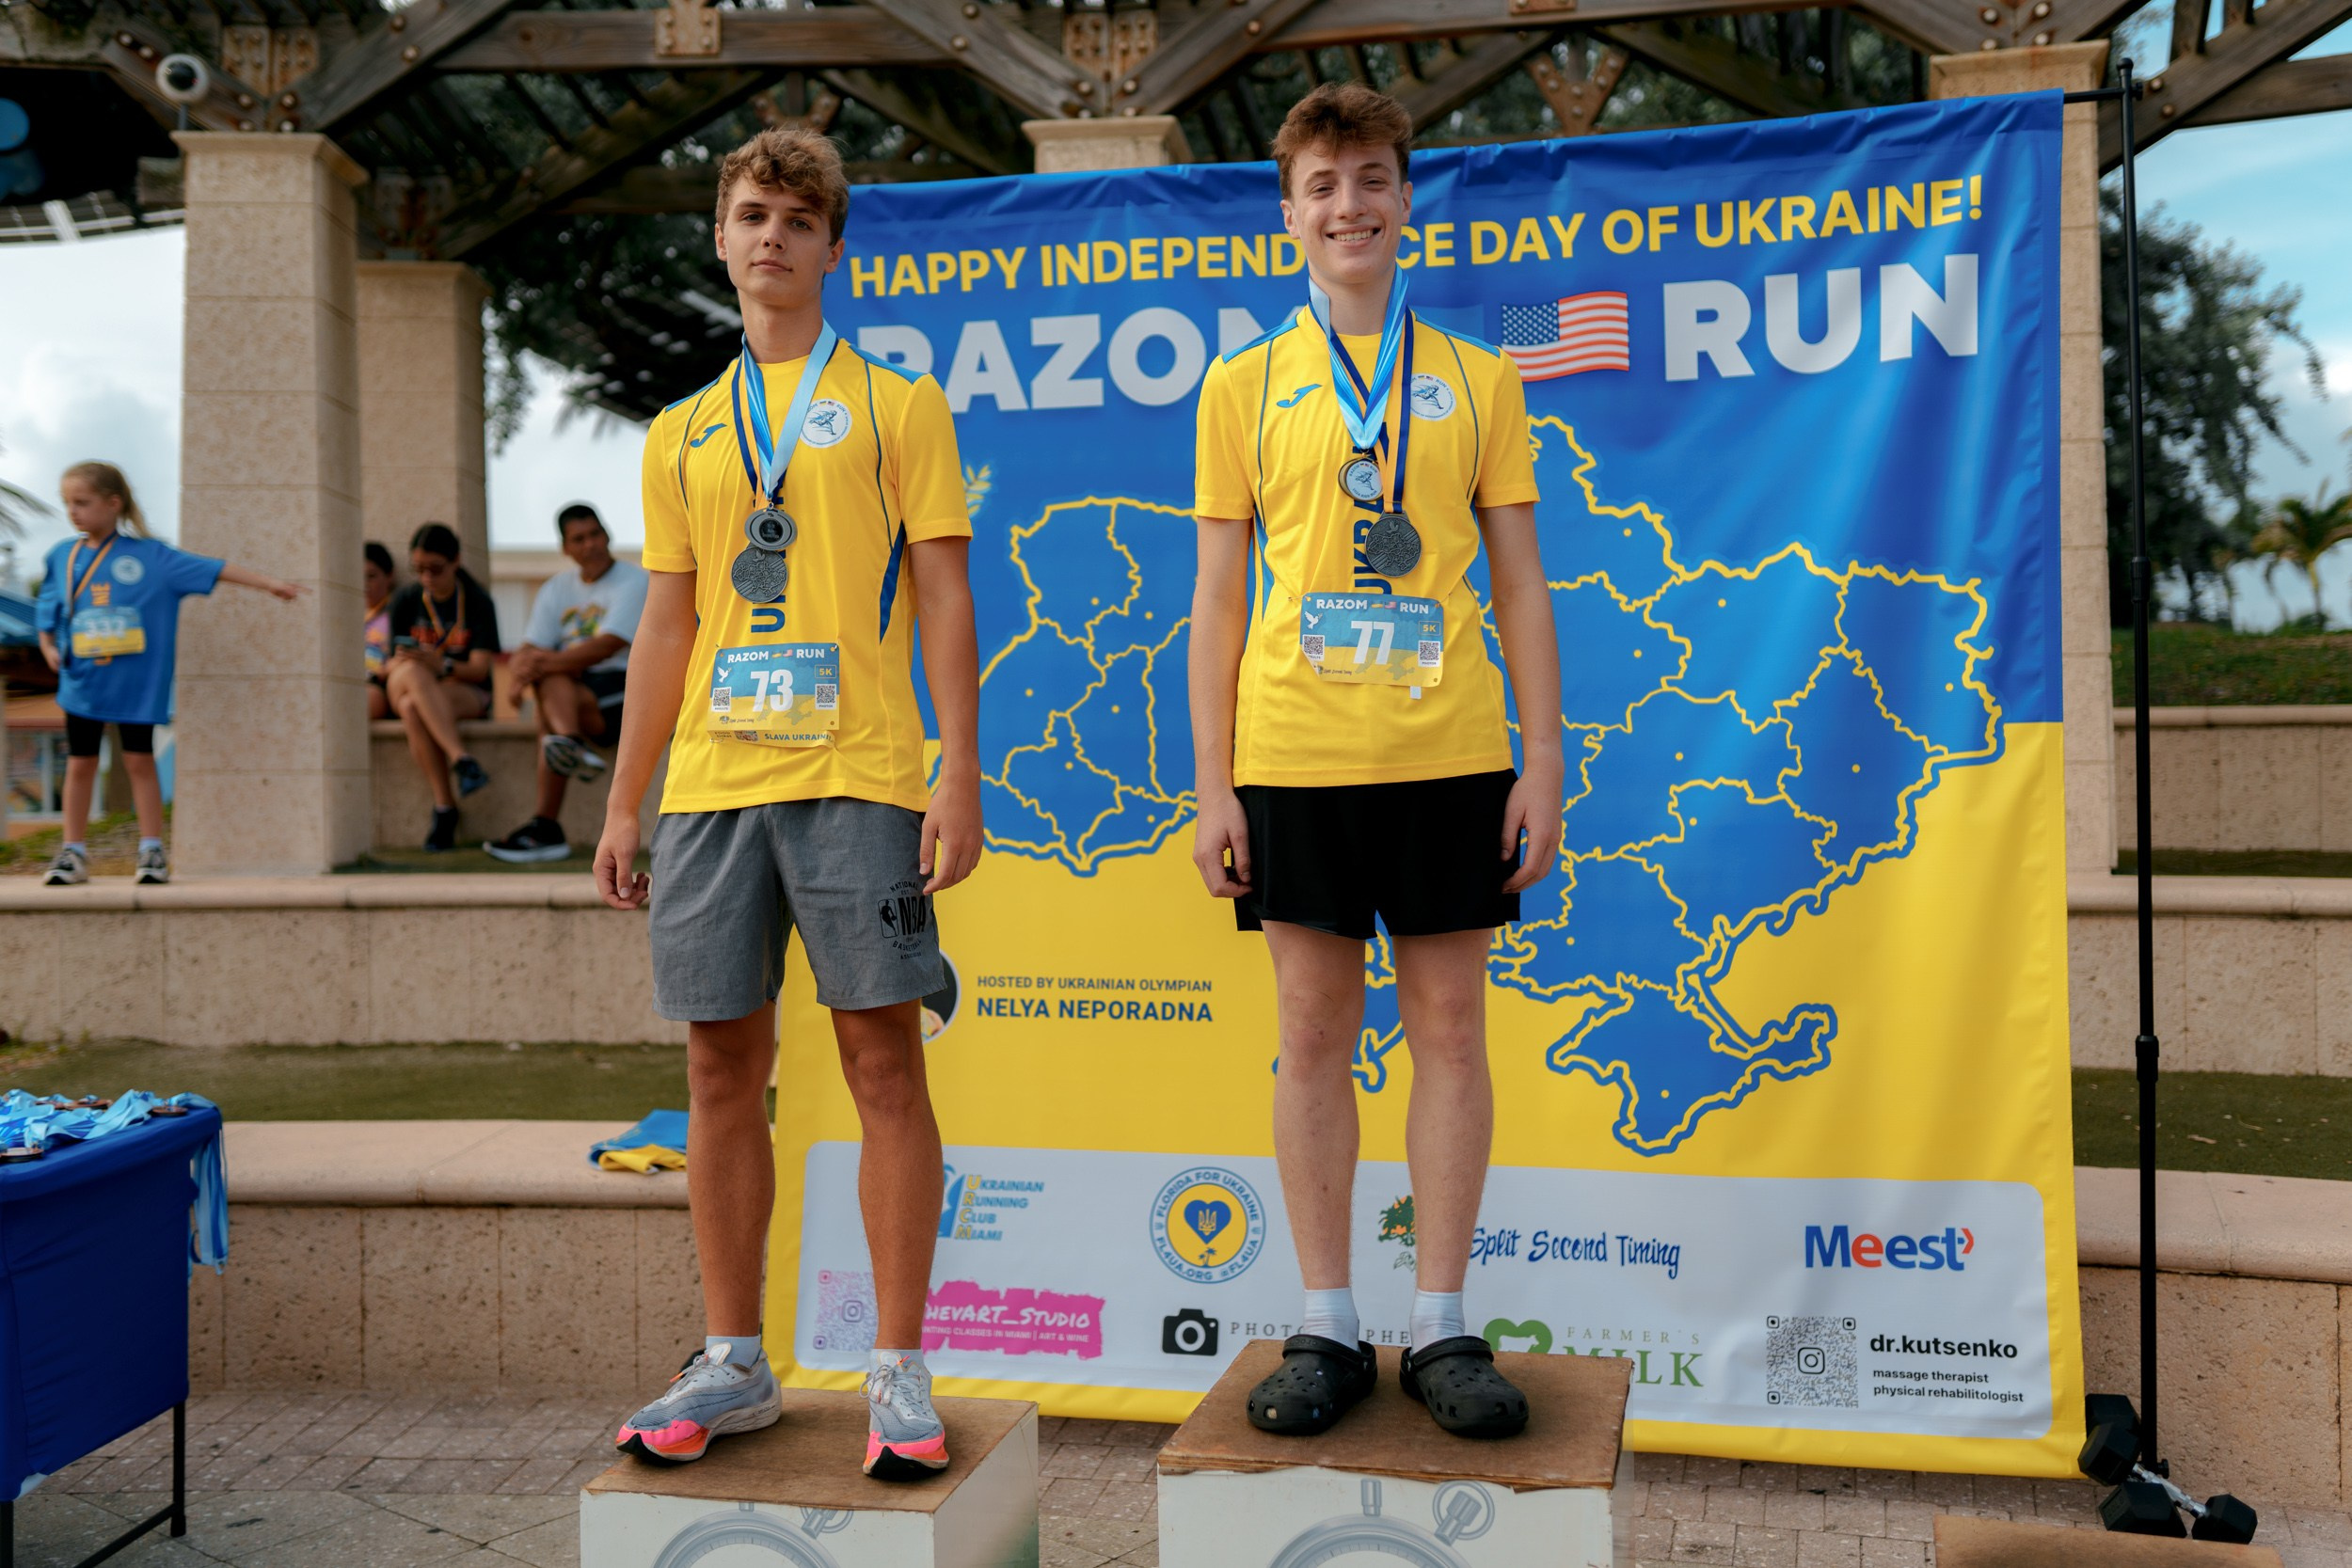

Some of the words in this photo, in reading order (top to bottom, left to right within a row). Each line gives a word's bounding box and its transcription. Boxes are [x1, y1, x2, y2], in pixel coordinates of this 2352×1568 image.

[850, 246, 1026, 297] HAPPY
[1041, 223, 1455, 286] INDEPENDCE
[1470, 213, 1586, 264] DAY
[1602, 206, 1679, 254] OF
[1694, 174, 1982, 248] UKRAINE!
[1662, 253, 1979, 382] RUN
[1316, 599, 1368, 610] RAZOM
[1400, 602, 1429, 614] RUN
[1351, 621, 1394, 665] 77
[727, 651, 769, 663] RAZOM
[796, 648, 825, 658] RUN
[818, 668, 833, 676] 5K
[750, 669, 794, 712] 73
[890, 880, 918, 893] NATIONAL
[898, 895, 926, 935] NBA
[977, 975, 1032, 989] HOSTED
[1037, 976, 1055, 989] BY
[1058, 977, 1136, 990] UKRAINIAN
[1138, 979, 1212, 992] OLYMPIAN
[977, 998, 1050, 1018] NELYA
[1058, 999, 1213, 1022] NEPORADNA
[967, 1175, 1044, 1192] UKRAINIAN
[962, 1192, 1029, 1209] RUNNING
[1156, 1176, 1192, 1217] FLORIDA
[1195, 1171, 1220, 1181] FOR
[1222, 1176, 1260, 1221] UKRAINE
[959, 1208, 996, 1224] CLUB
[954, 1225, 1003, 1241] MIAMI
[1156, 1236, 1213, 1280] FL4UA.ORG
[1469, 1227, 1521, 1265] Split
[1527, 1230, 1608, 1262] Second
[1615, 1235, 1680, 1279] Timing
[1805, 1225, 1966, 1271] Meest
[1870, 1335, 2018, 1359] dr.kutsenko
[1873, 1370, 1929, 1382] massage
[1931, 1370, 1989, 1384] therapist
[1873, 1386, 1926, 1398] physical
[1928, 1387, 2024, 1403] rehabilitologist
